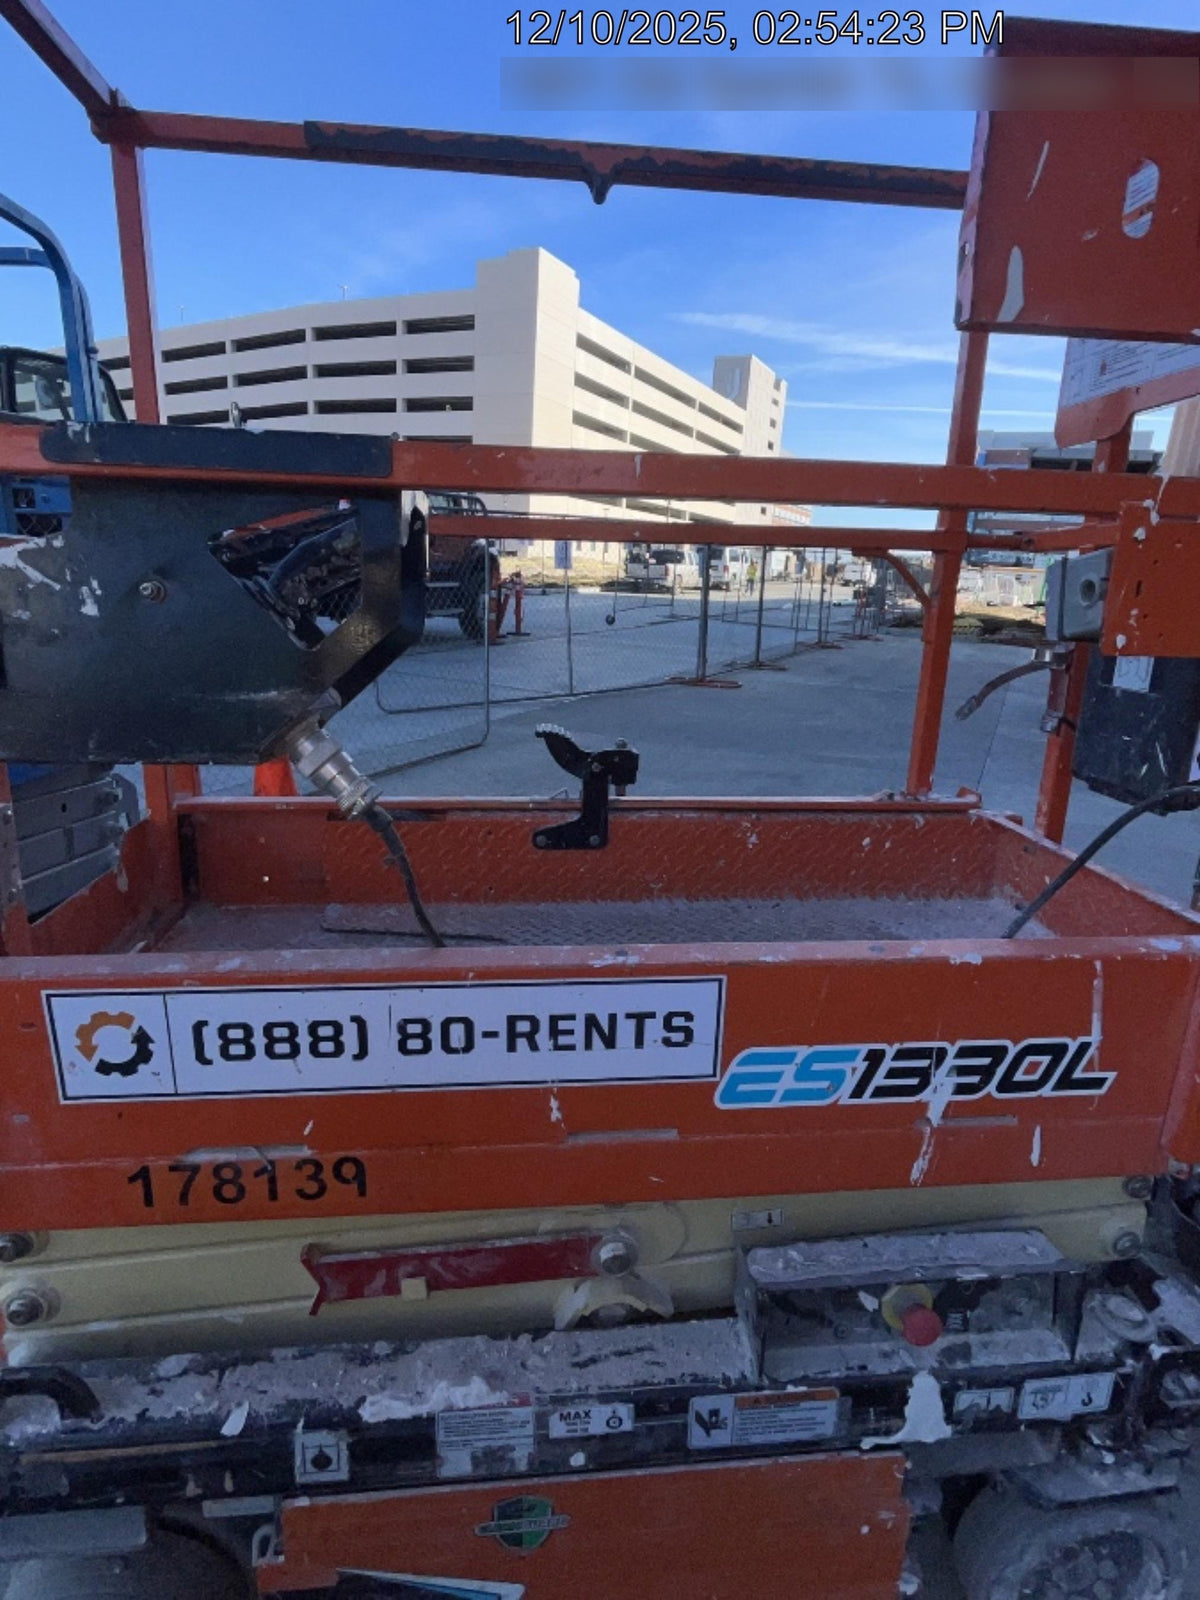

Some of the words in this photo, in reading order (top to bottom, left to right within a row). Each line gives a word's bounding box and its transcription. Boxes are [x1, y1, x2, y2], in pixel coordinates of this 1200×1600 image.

[192, 1014, 370, 1065] (888)
[396, 1010, 696, 1057] 80-RENTS
[715, 1038, 1115, 1107] ES1330L
[127, 1155, 369, 1209] 178139
[559, 1409, 592, 1422] MAX
